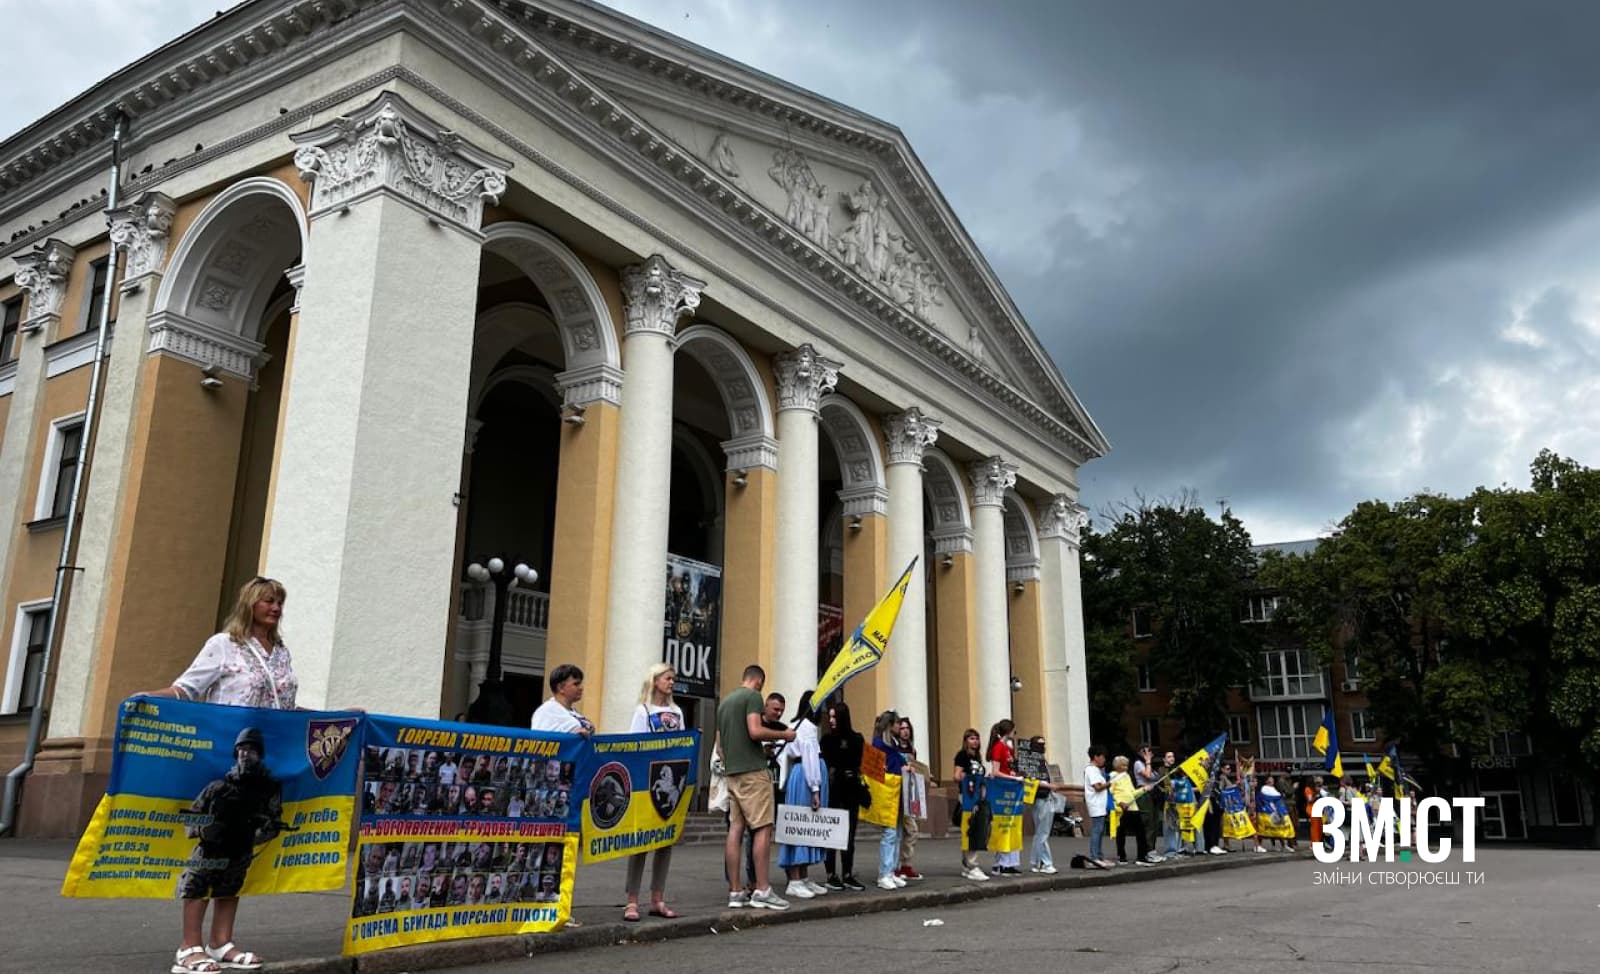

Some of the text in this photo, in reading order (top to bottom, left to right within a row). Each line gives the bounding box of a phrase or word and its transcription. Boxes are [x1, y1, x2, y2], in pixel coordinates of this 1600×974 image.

[405, 729, 456, 746] ОКРЕМА
[460, 733, 513, 752] ТАНКОВА
[514, 740, 561, 757] БРИГАДА
[360, 919, 398, 939] ОКРЕМА
[403, 912, 448, 932] БРИГАДА
[452, 907, 508, 927] МОРСЬКОЇ
[511, 907, 558, 923] ПІХОТИ
